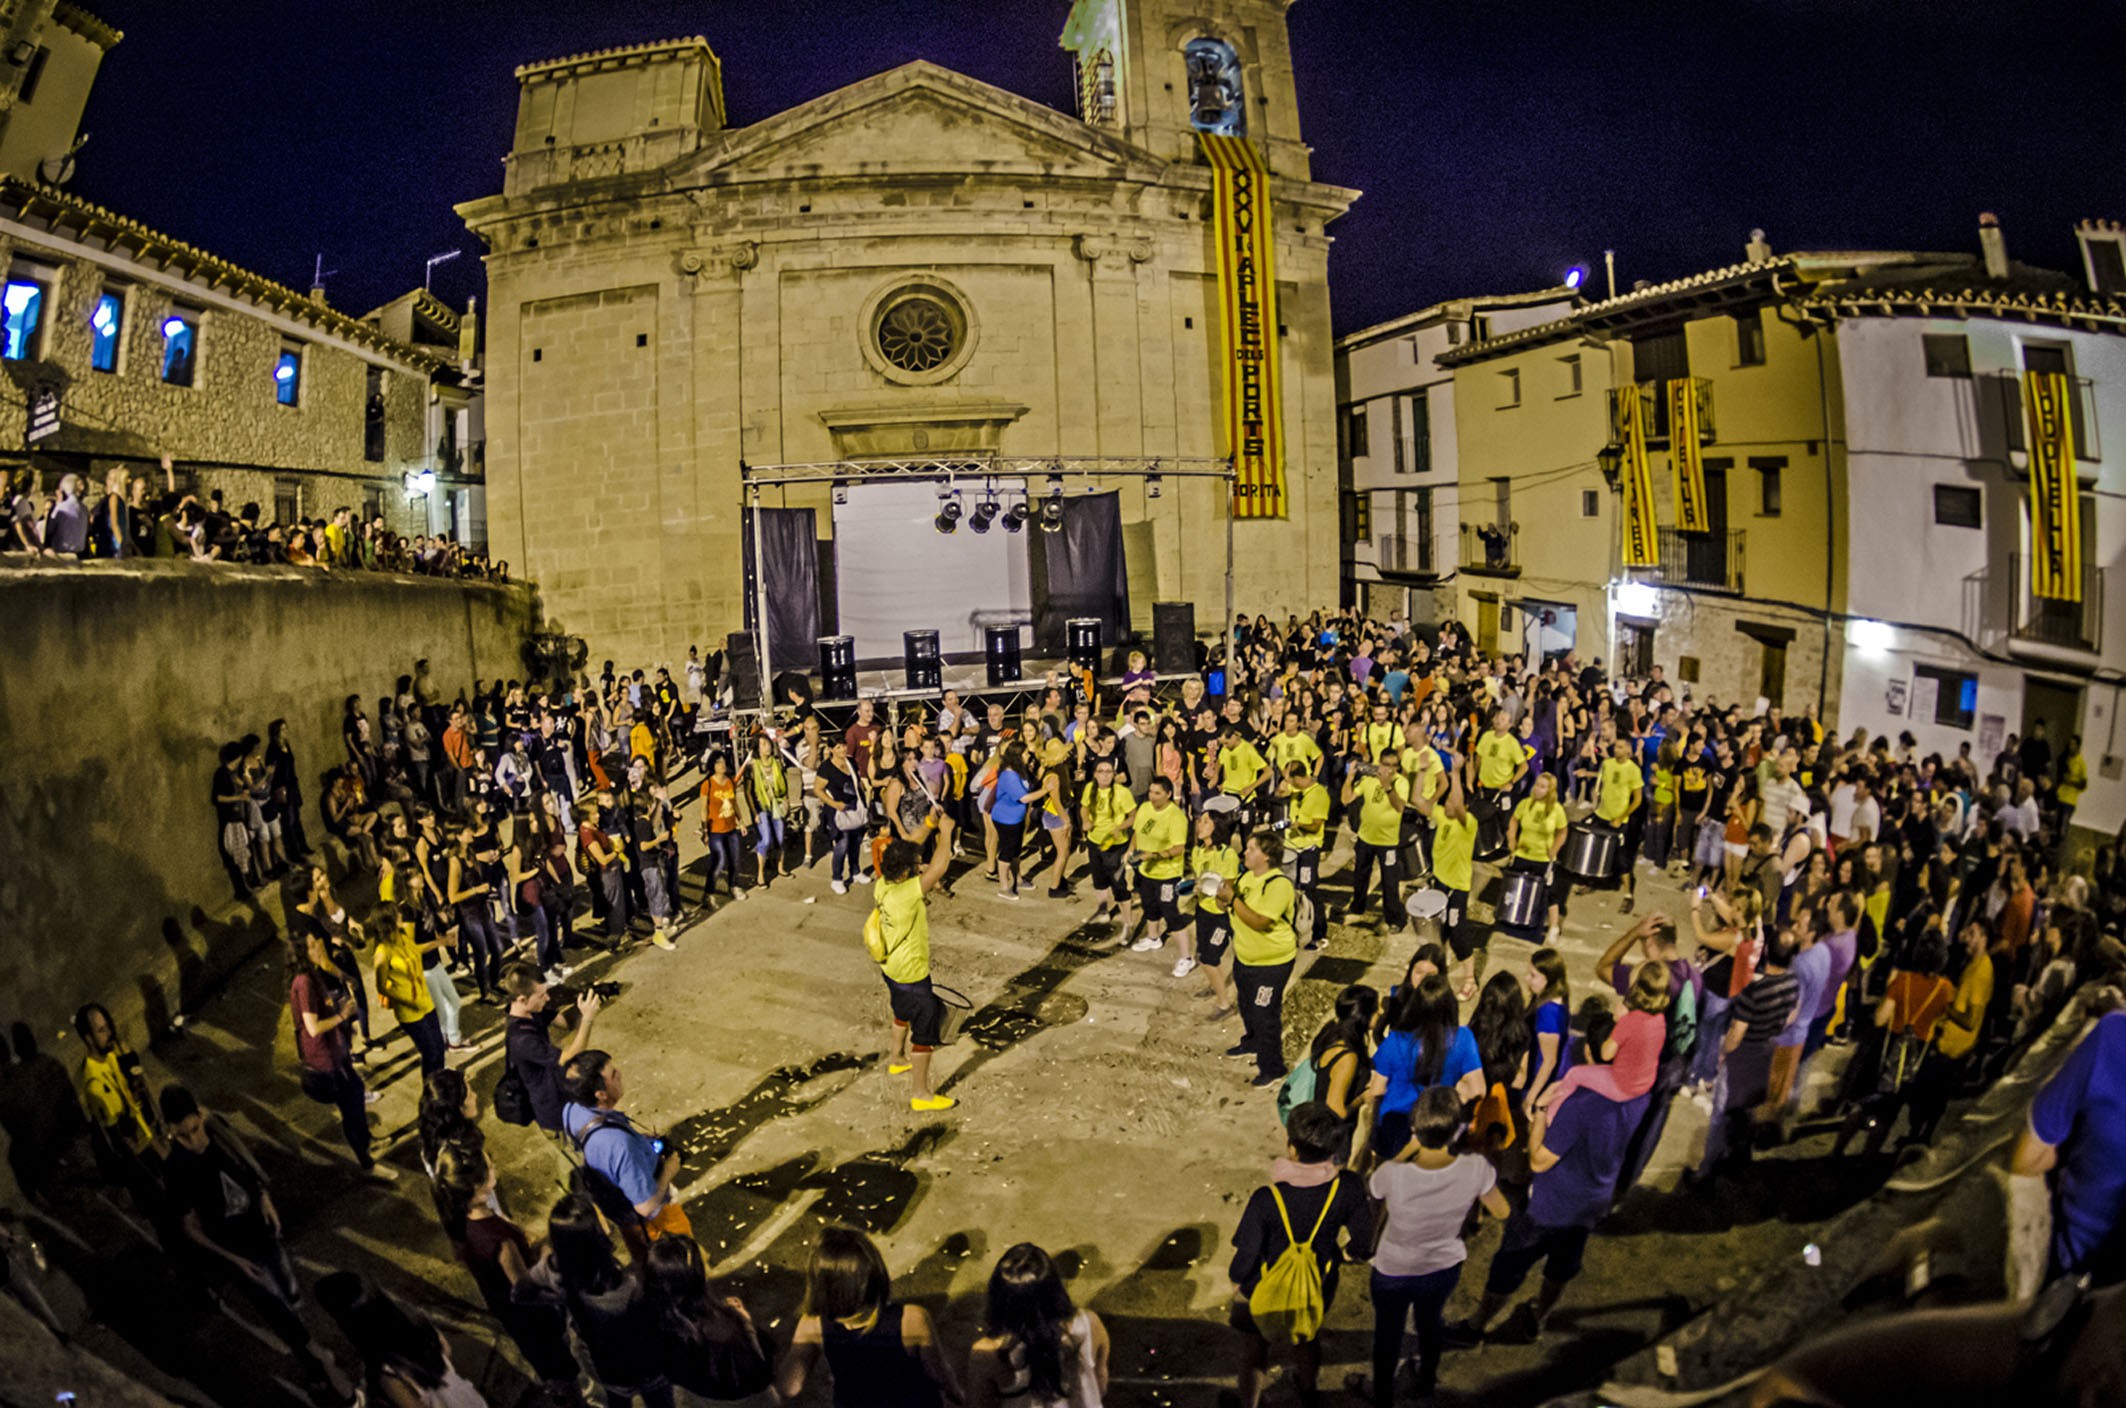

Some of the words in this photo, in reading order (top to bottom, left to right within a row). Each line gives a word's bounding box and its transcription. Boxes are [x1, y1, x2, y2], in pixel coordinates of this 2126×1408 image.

[1238, 257, 1260, 345] APLEC
[1236, 349, 1263, 360] DELS
[1242, 365, 1262, 456] PORTS
